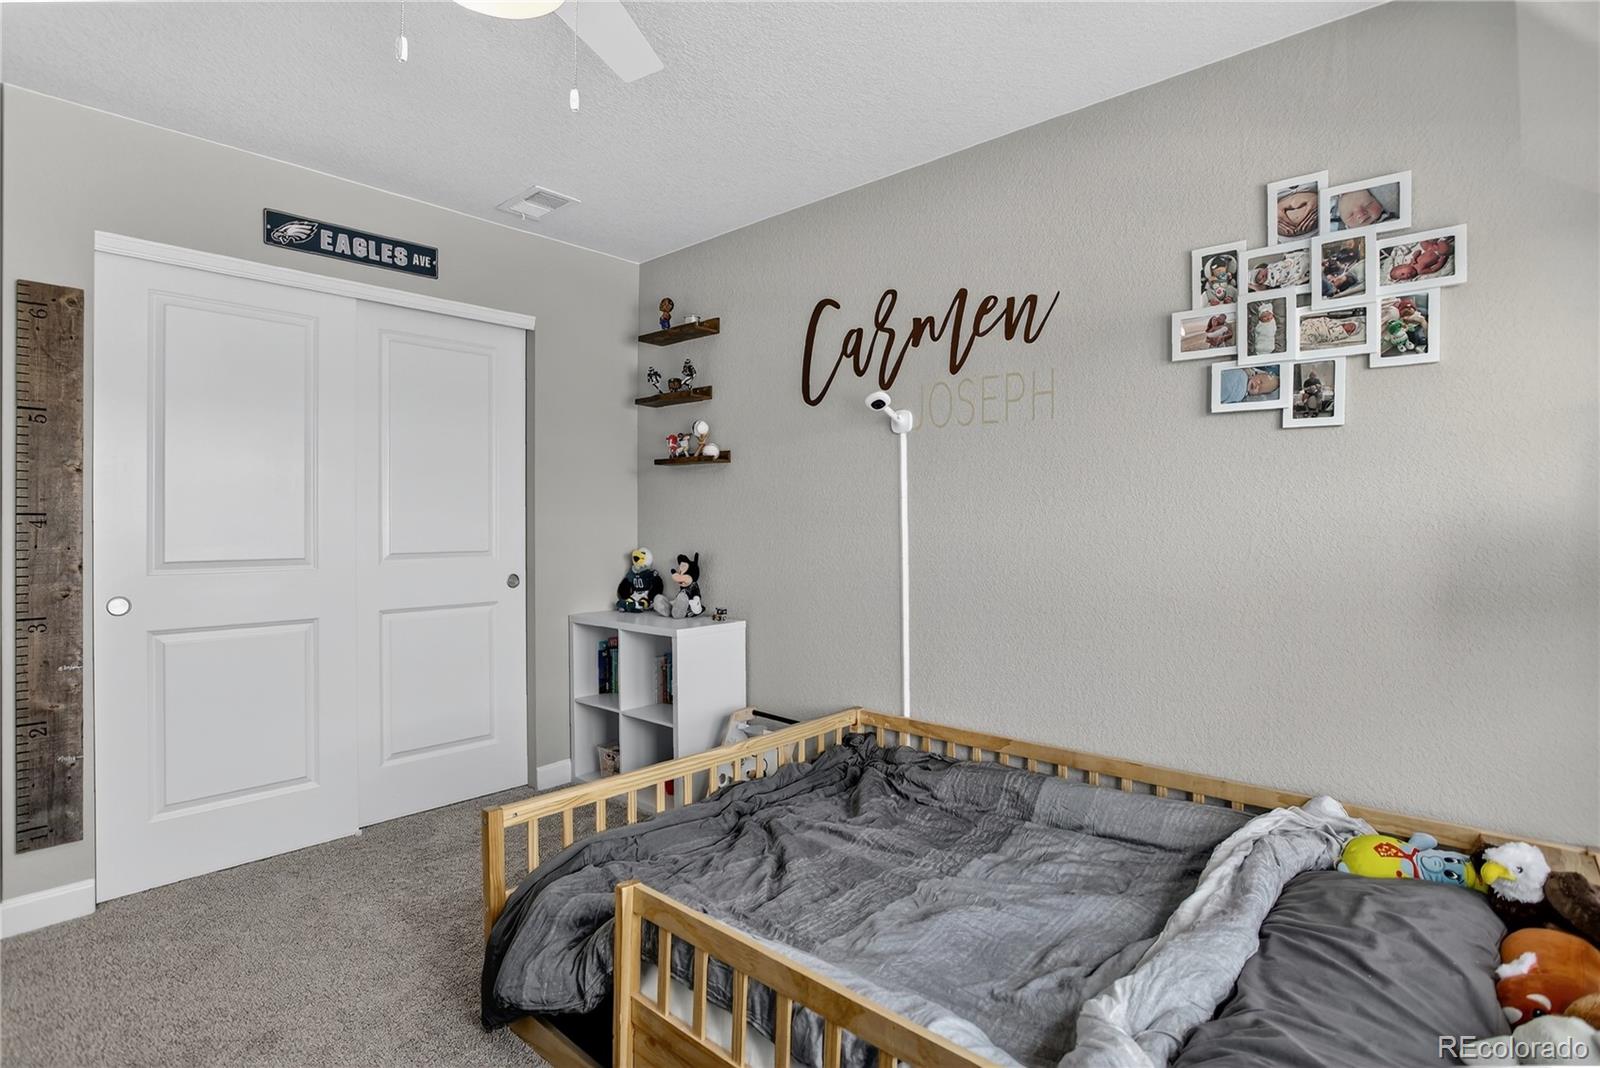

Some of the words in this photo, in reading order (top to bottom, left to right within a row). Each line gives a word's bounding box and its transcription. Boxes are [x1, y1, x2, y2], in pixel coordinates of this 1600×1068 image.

[320, 229, 408, 267] EAGLES
[412, 253, 431, 268] AVE
[28, 308, 48, 319] 6
[801, 287, 1060, 407] Carmen
[911, 368, 1055, 432] JOSEPH
[28, 414, 48, 425] 5
[28, 518, 48, 529] 4
[27, 623, 48, 633] 3
[28, 727, 48, 739] 2
[30, 833, 48, 843] 1
